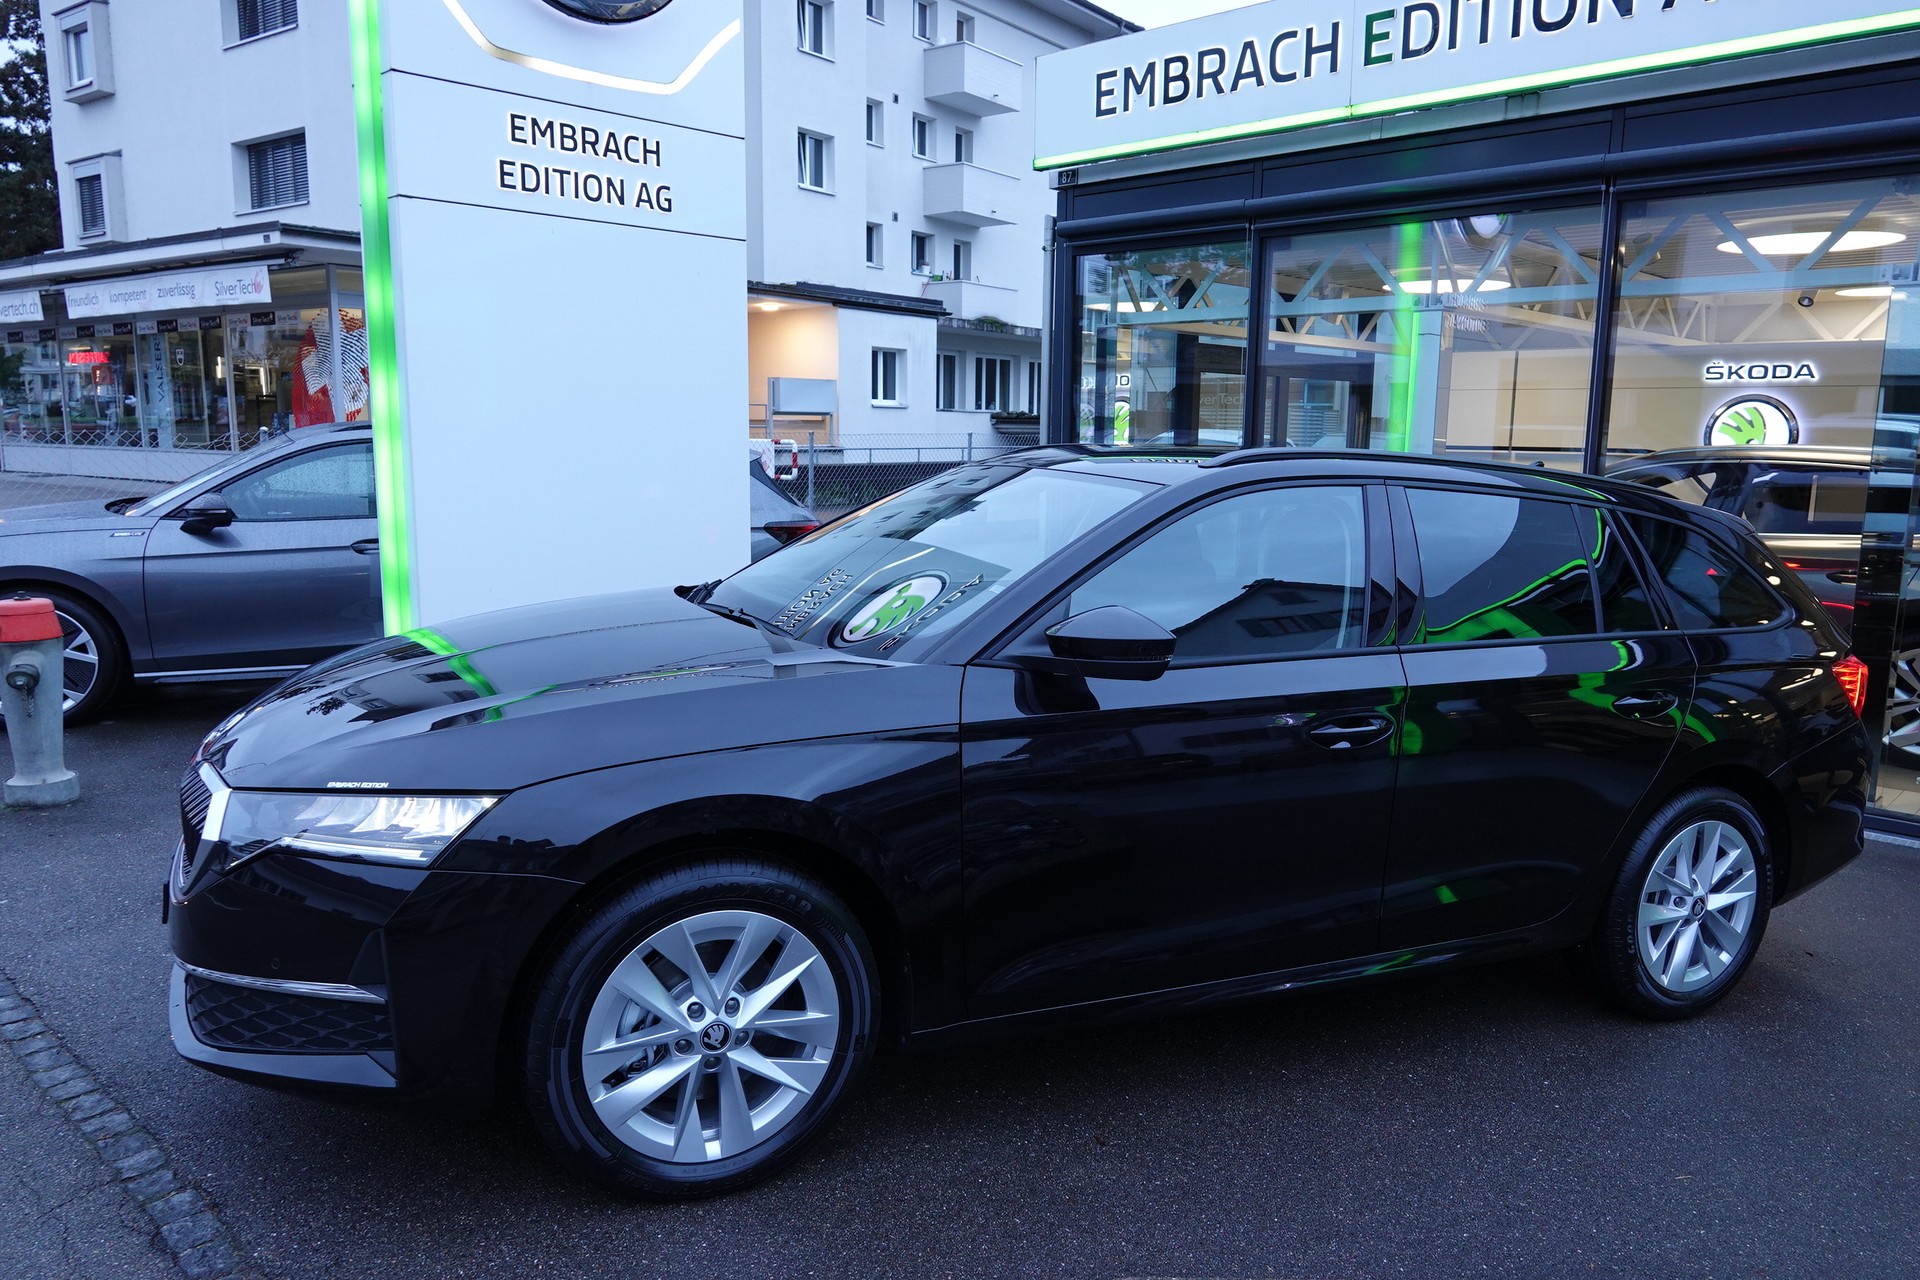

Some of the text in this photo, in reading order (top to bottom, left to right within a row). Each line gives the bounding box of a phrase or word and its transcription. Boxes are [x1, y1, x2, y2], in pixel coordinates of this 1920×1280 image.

[1095, 21, 1340, 118] EMBRACH
[509, 113, 661, 167] EMBRACH
[499, 159, 673, 213] EDITION AG
[1062, 171, 1073, 184] 87
[67, 291, 100, 308] freundlich
[109, 290, 147, 305] kompetent
[154, 341, 165, 402] VALSER
[1704, 361, 1816, 381] ŠKODA
